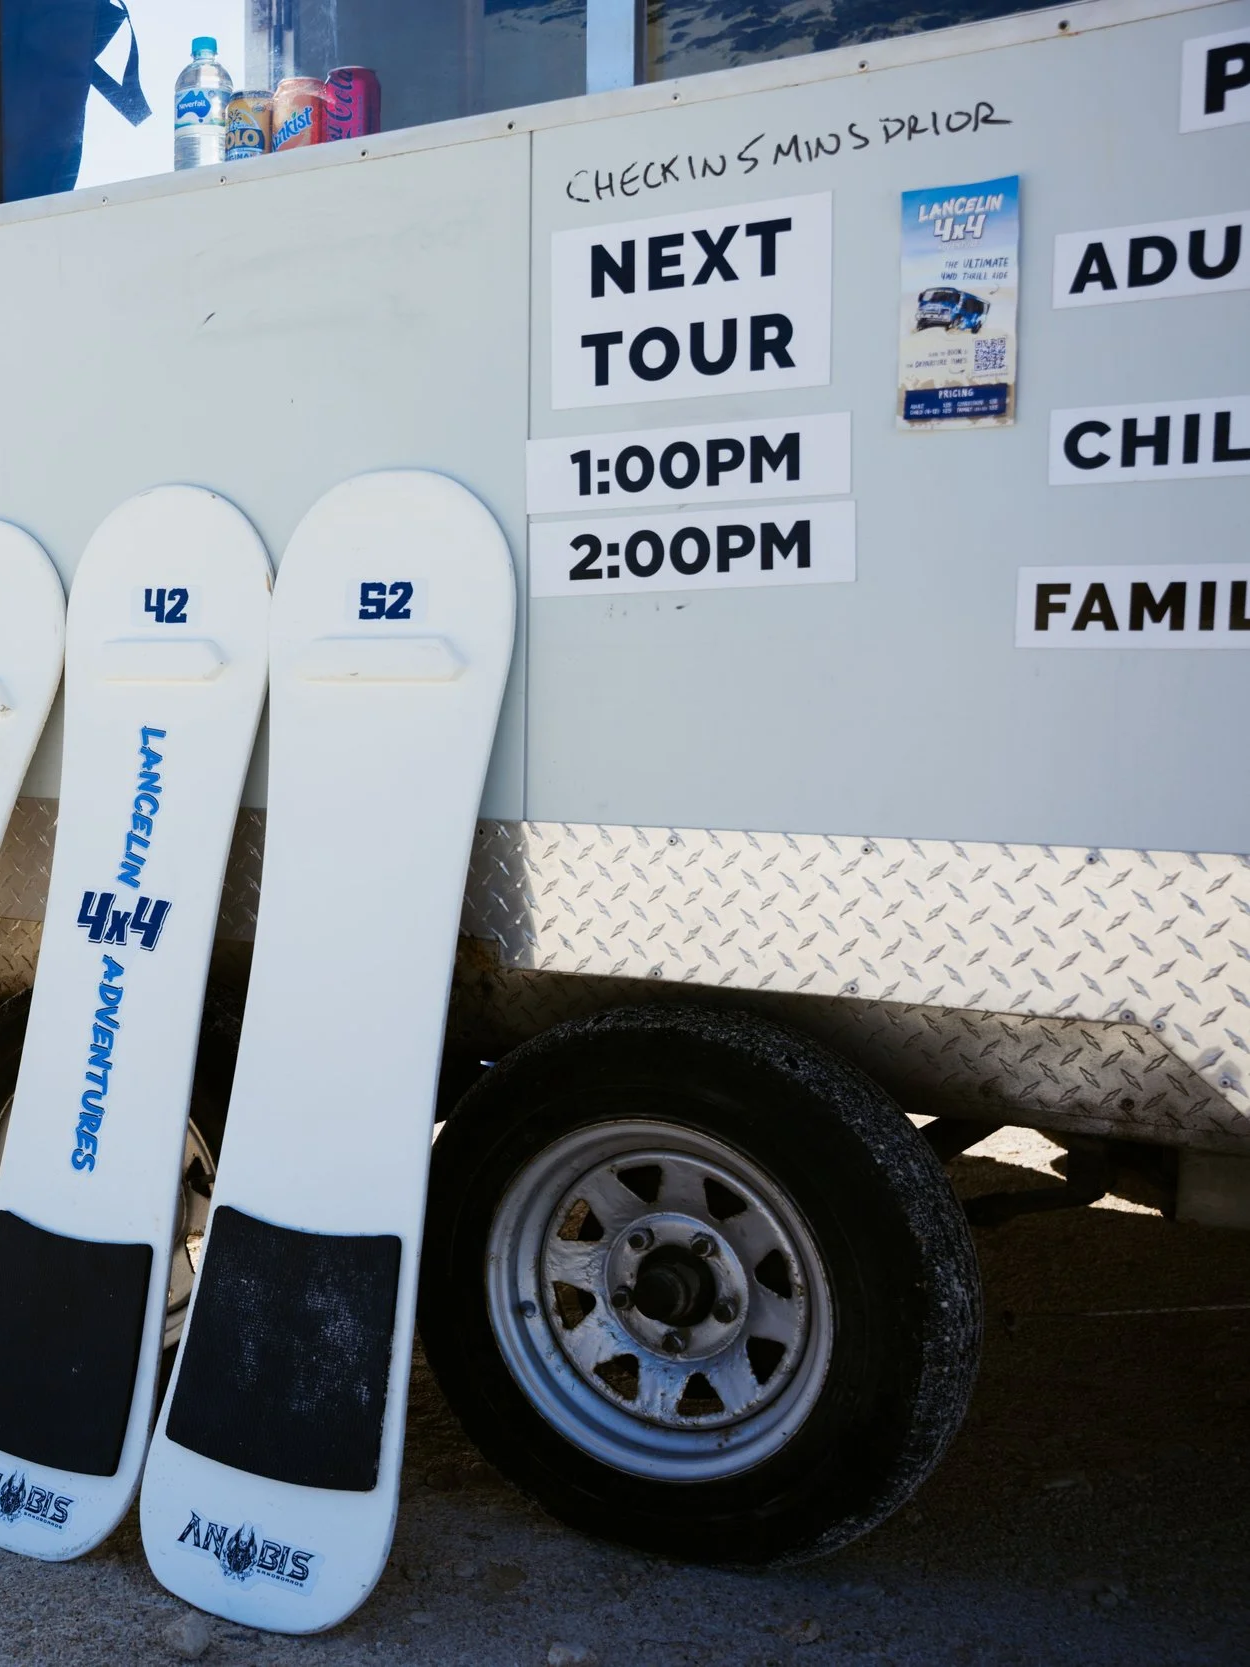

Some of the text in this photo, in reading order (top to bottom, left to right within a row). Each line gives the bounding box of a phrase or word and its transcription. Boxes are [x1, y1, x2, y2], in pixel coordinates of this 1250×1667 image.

[226, 130, 260, 149] OLO
[272, 106, 312, 149] unkist
[773, 122, 870, 165] MINS
[918, 194, 1004, 222] LANCELIN
[934, 214, 986, 242] 4x4
[591, 217, 792, 298] NEXT
[945, 257, 1009, 269] THE ULTIMATE
[581, 313, 796, 386] TOUR
[938, 388, 975, 399] PRICING
[570, 432, 800, 496] 1:00PM
[569, 520, 811, 581] 2:00PM
[144, 588, 189, 623] 42
[359, 581, 413, 620] 52
[117, 725, 167, 889] LANCELIN
[77, 890, 172, 951] 4x4
[70, 954, 125, 1174] ADVENTURES
